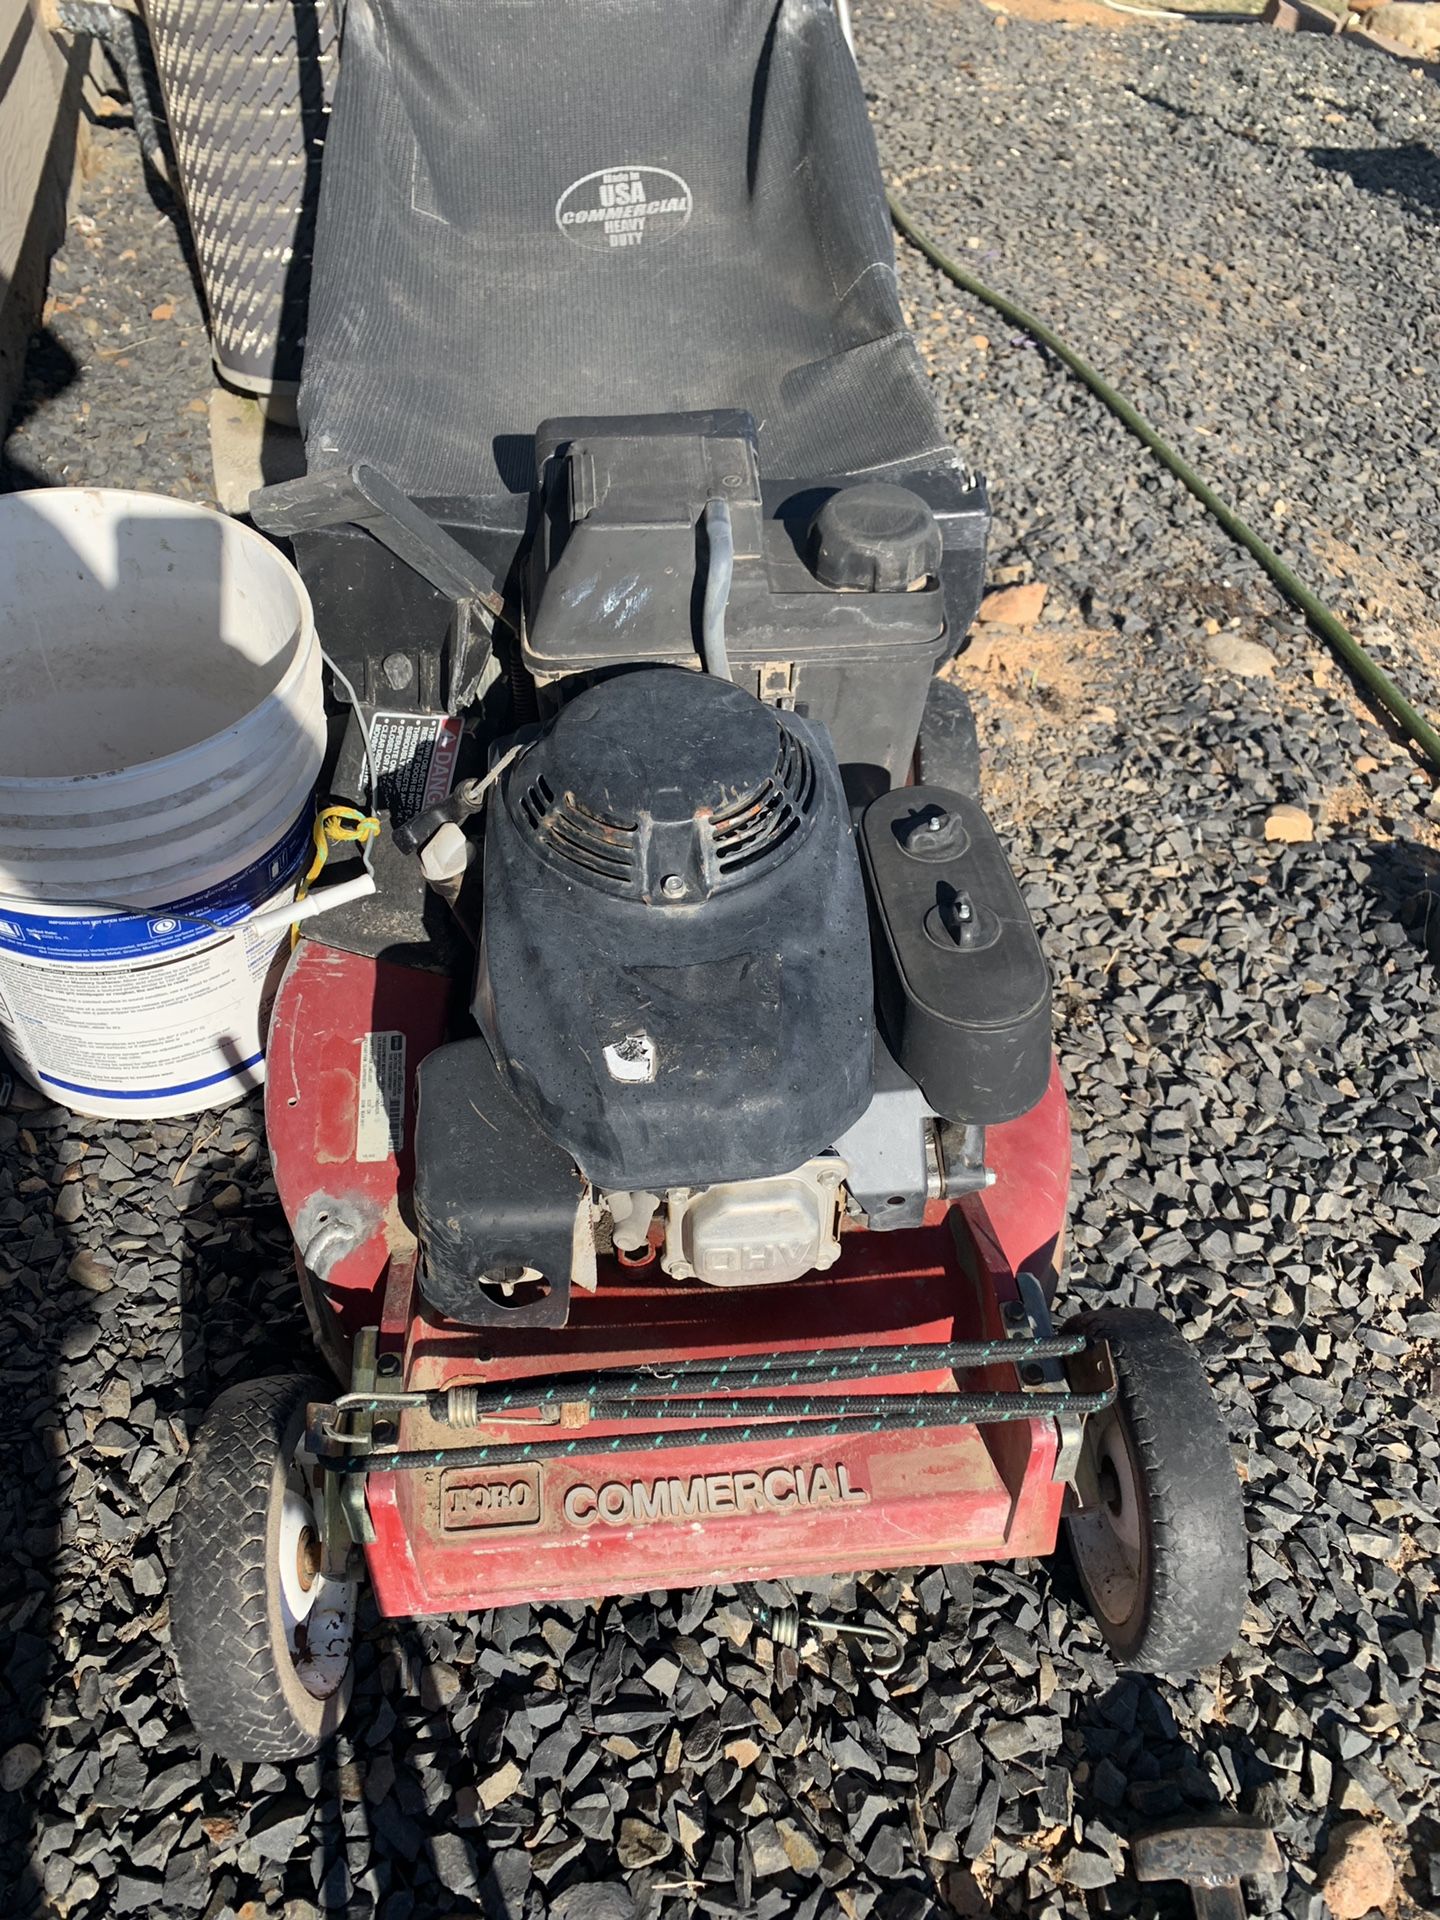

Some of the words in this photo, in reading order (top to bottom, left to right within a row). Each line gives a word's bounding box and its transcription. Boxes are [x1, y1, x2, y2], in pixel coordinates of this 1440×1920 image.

[599, 181, 647, 207] USA
[562, 197, 688, 225] COMMERCIAL
[604, 217, 647, 234] HEAVY
[609, 232, 644, 248] DUTY
[377, 725, 389, 748] CLEAR
[385, 725, 397, 753] CLOSED
[391, 725, 405, 759] OPERATE
[399, 726, 413, 766] SERIOUSLY
[408, 726, 420, 758] THROWN
[425, 752, 453, 807] DANG
[702, 1240, 812, 1272] OHV
[446, 1479, 532, 1512] TORO
[563, 1462, 869, 1526] COMMERCIAL
